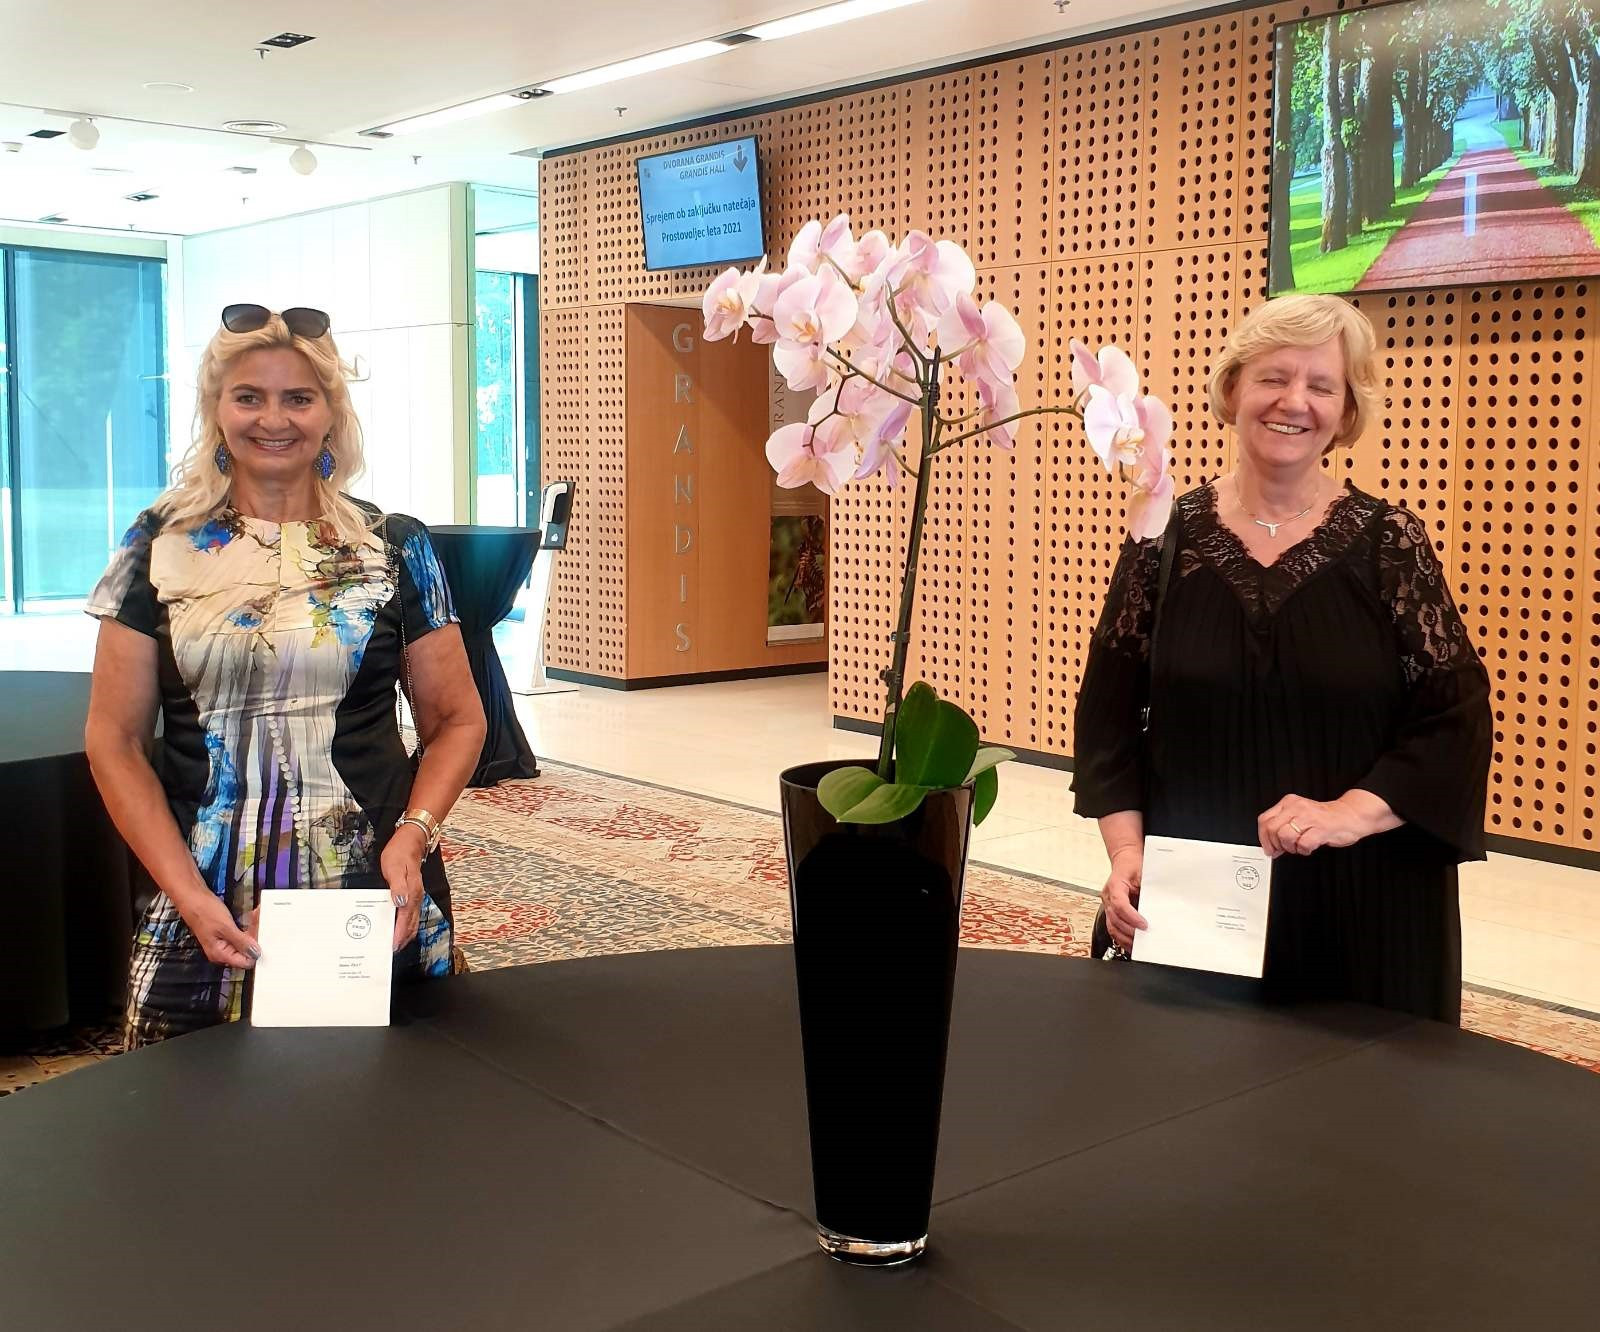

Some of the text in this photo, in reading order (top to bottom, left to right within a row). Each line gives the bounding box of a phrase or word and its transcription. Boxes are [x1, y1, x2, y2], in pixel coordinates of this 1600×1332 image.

[663, 150, 725, 169] DVORANA GRANDIS
[680, 166, 708, 180] GRANDIS
[646, 197, 756, 225] Sprejem ob zaključku natečaja
[661, 222, 742, 243] Prostovoljec leta 2021
[672, 323, 694, 652] GRANDIS
